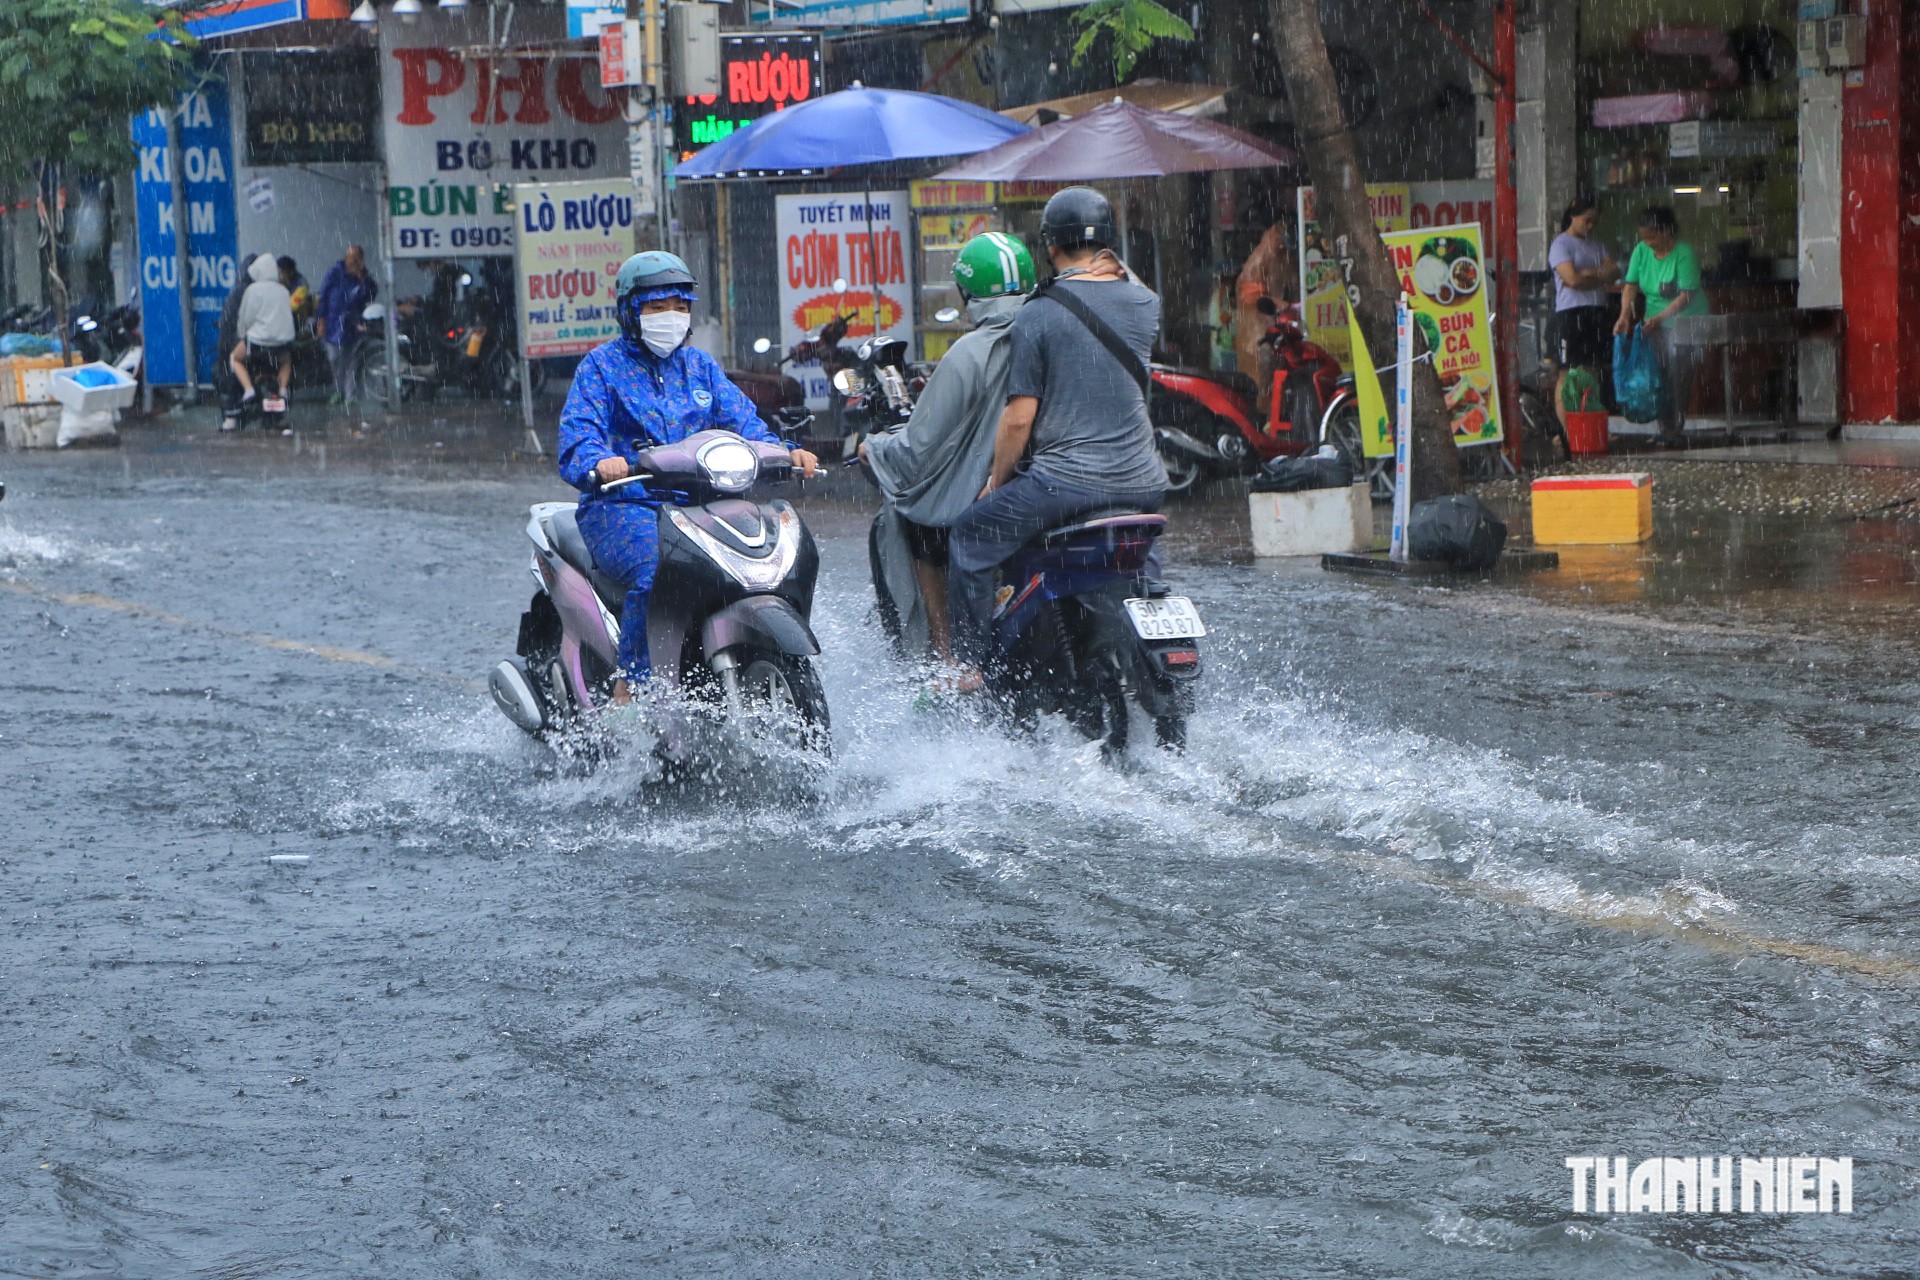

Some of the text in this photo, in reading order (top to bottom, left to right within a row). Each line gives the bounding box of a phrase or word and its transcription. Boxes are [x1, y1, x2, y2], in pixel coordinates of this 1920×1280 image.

[728, 51, 811, 113] RƯỢU
[511, 137, 598, 171] KHO
[388, 178, 478, 216] BÚN
[523, 192, 633, 237] LÒ RƯỢU
[798, 199, 845, 224] TUYẾT
[786, 224, 906, 289] CƠM TRƯA
[528, 267, 596, 304] RƯỢU
[1439, 311, 1474, 334] BÚN
